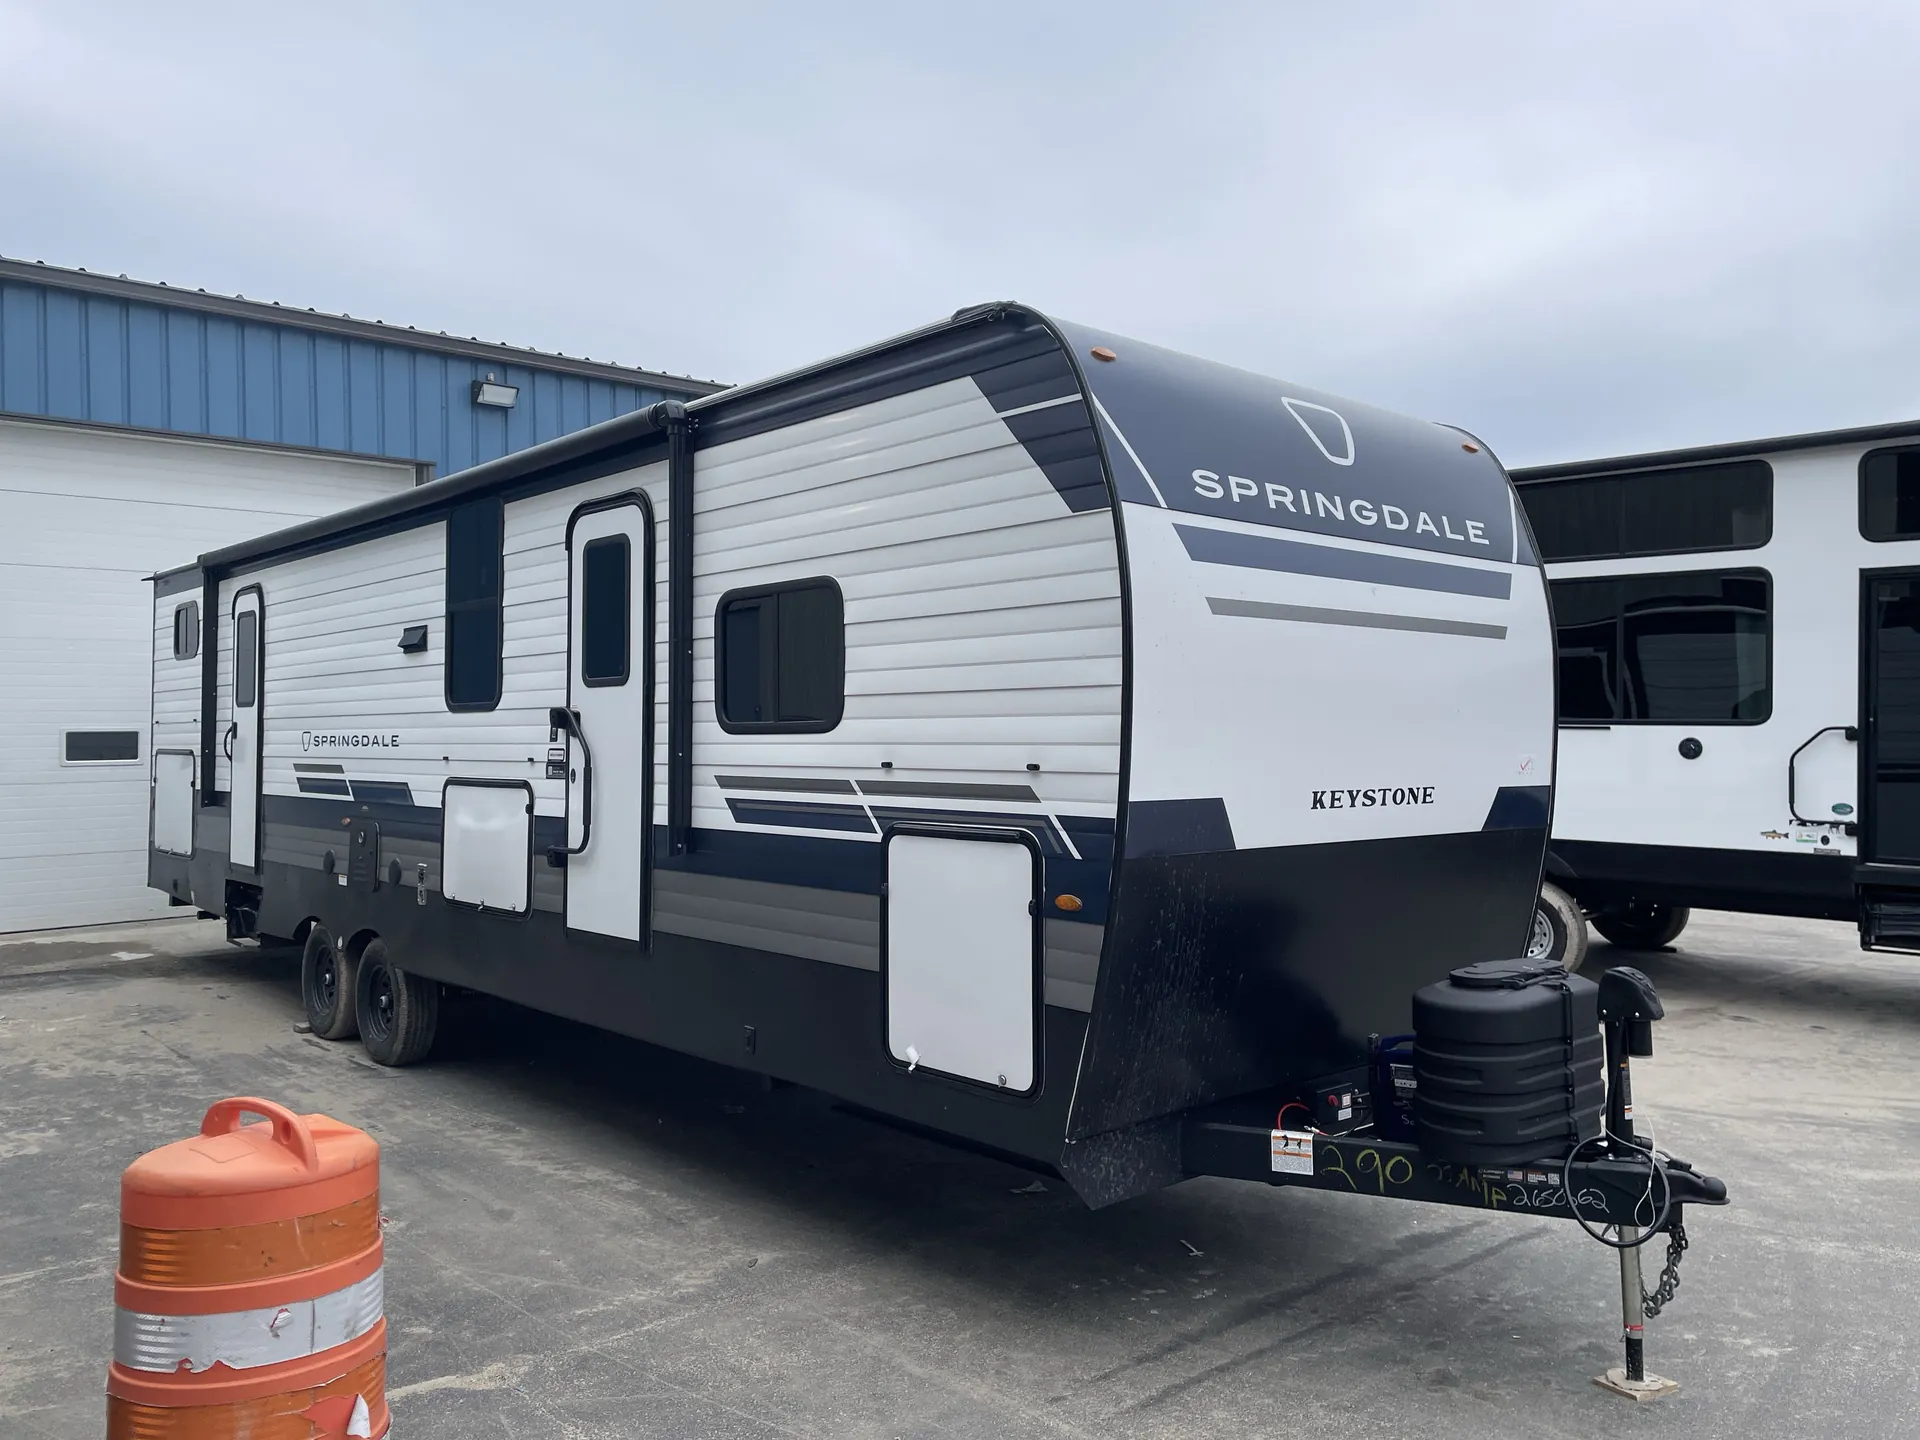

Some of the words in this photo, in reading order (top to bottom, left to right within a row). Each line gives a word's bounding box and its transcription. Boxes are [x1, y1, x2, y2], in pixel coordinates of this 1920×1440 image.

[1192, 469, 1490, 545] SPRINGDALE
[313, 735, 400, 747] SPRINGDALE
[1310, 786, 1435, 810] KEYSTONE
[1320, 1145, 1413, 1194] 290
